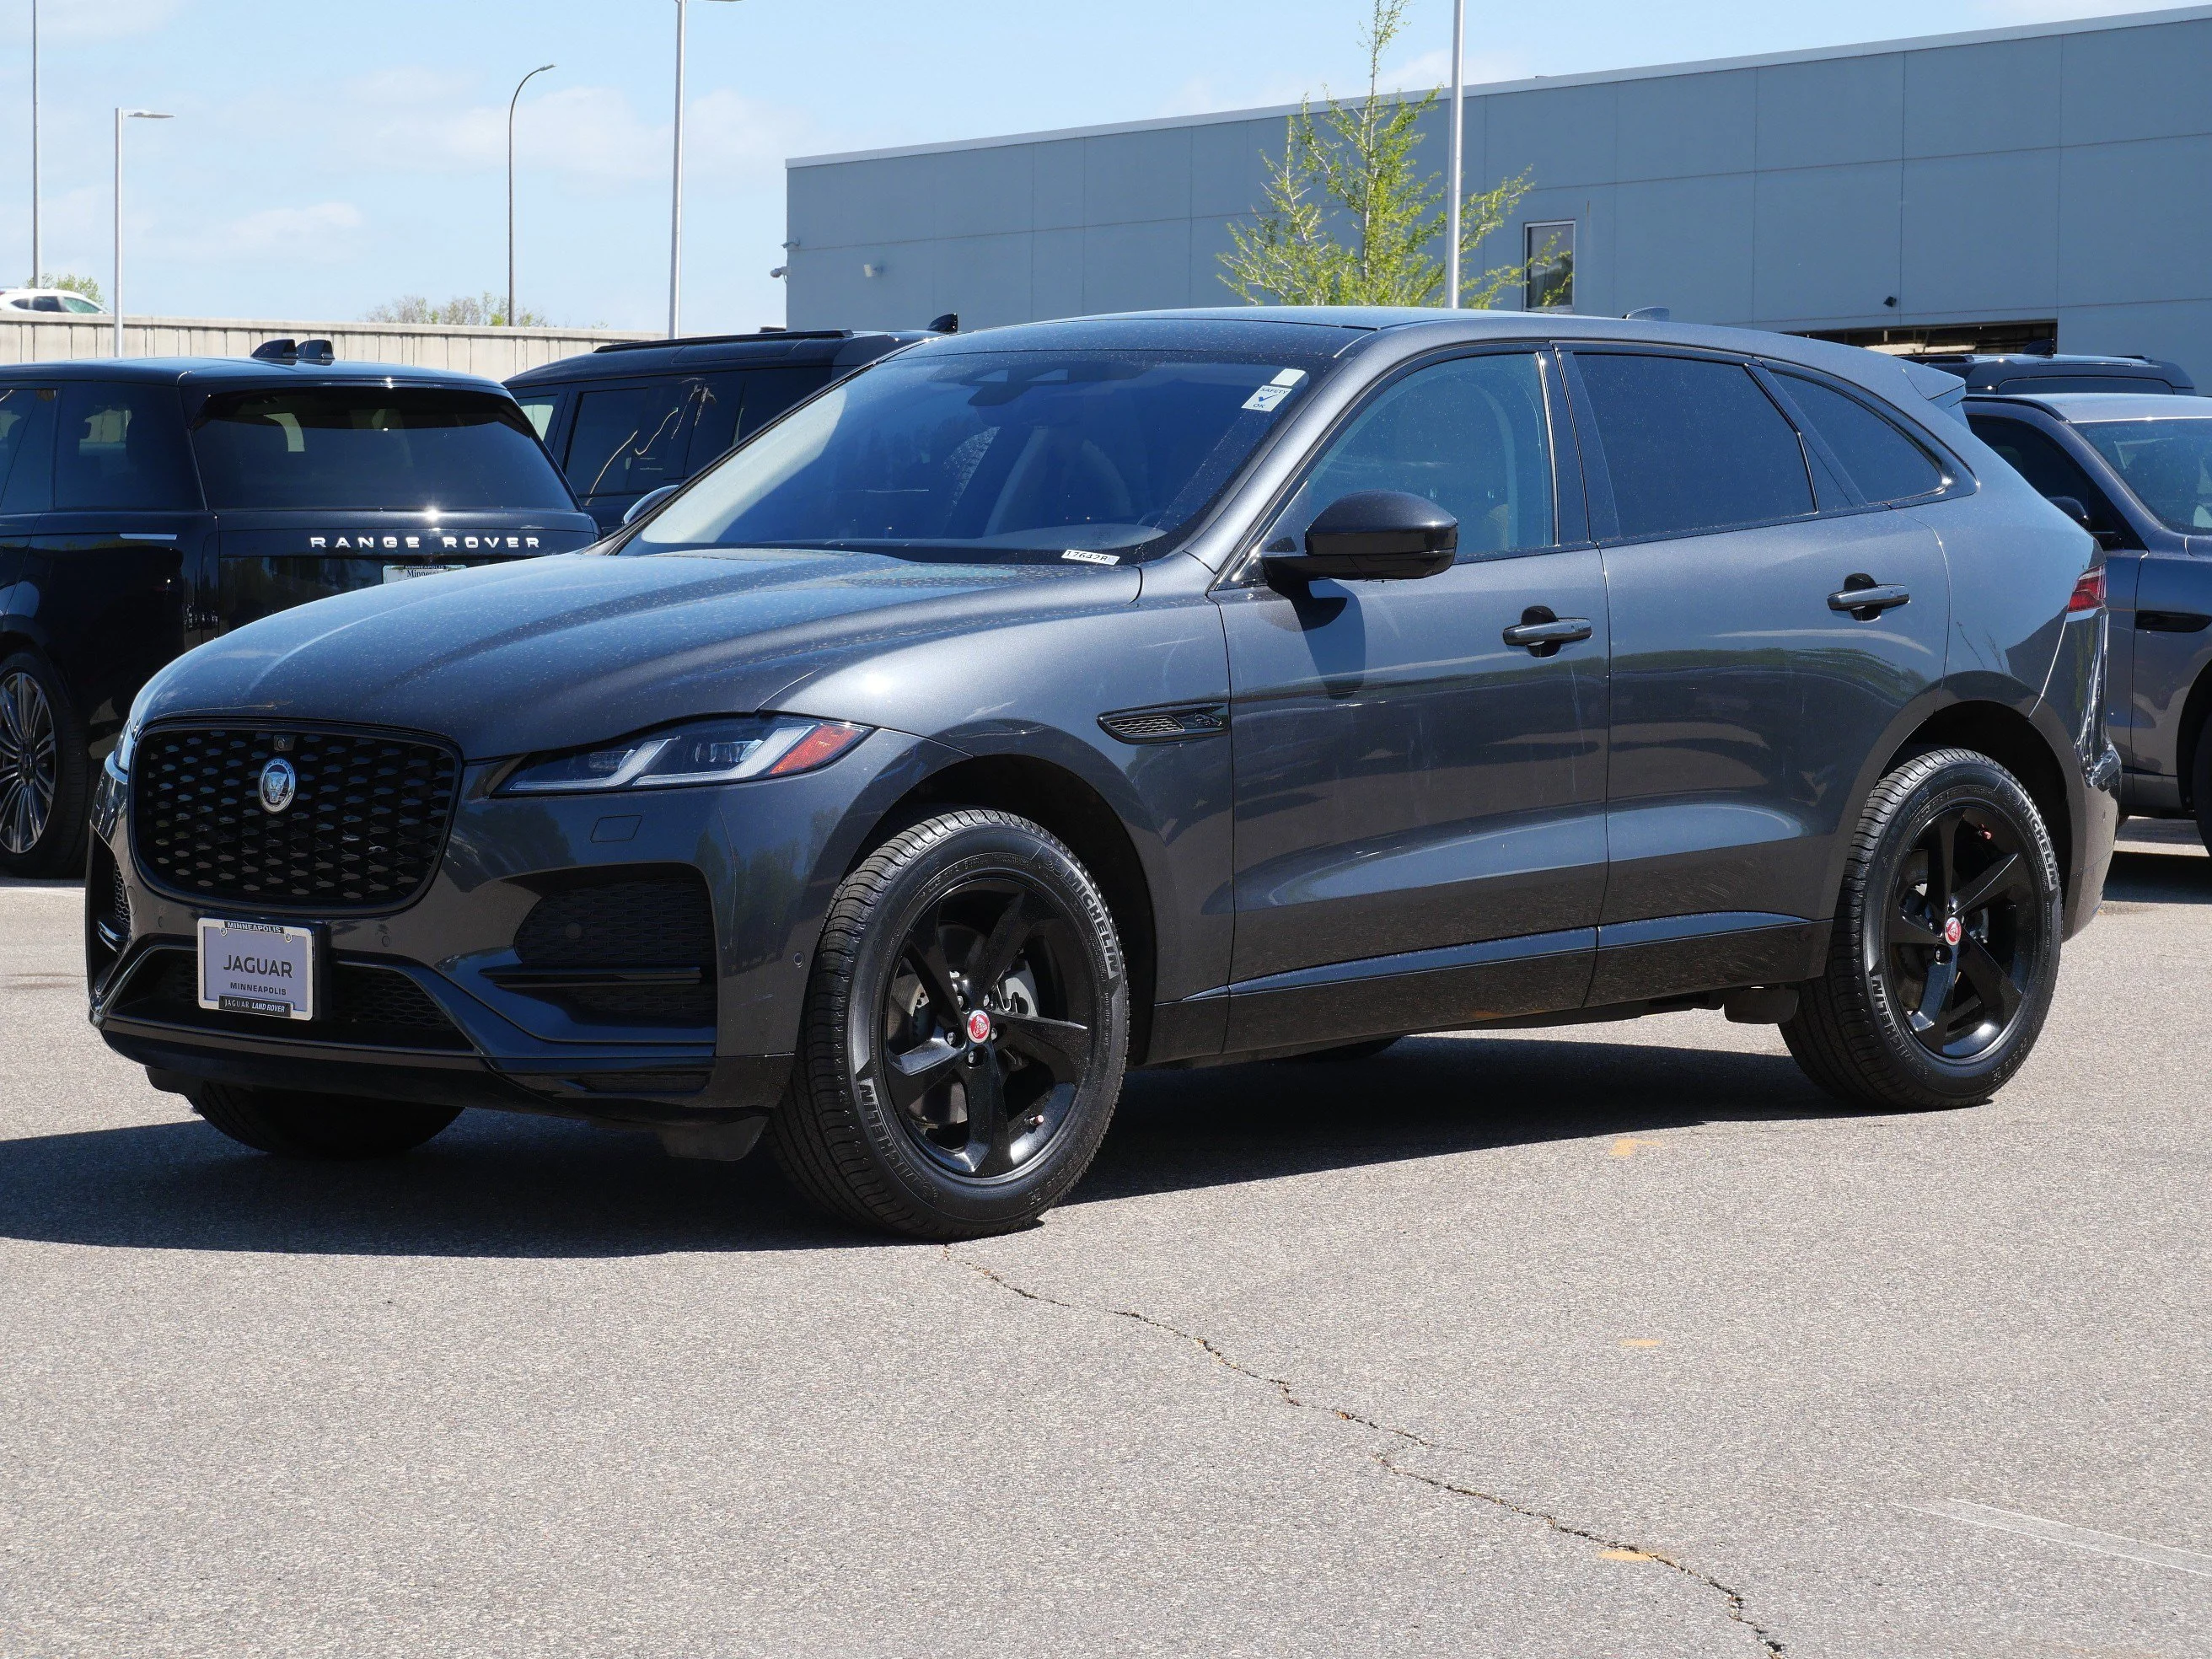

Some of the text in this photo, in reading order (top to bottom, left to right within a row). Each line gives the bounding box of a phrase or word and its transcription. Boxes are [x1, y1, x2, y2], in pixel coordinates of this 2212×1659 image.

[310, 537, 540, 548] RANGE ROVER
[2021, 804, 2057, 886] MICHELIN
[227, 921, 282, 933] MINNEAPOLIS
[1065, 869, 1119, 972] MICHELIN
[223, 954, 293, 979] JAGUAR
[230, 982, 287, 996] MINNEAPOLIS
[224, 999, 285, 1013] JAGUAR LAND ROVER
